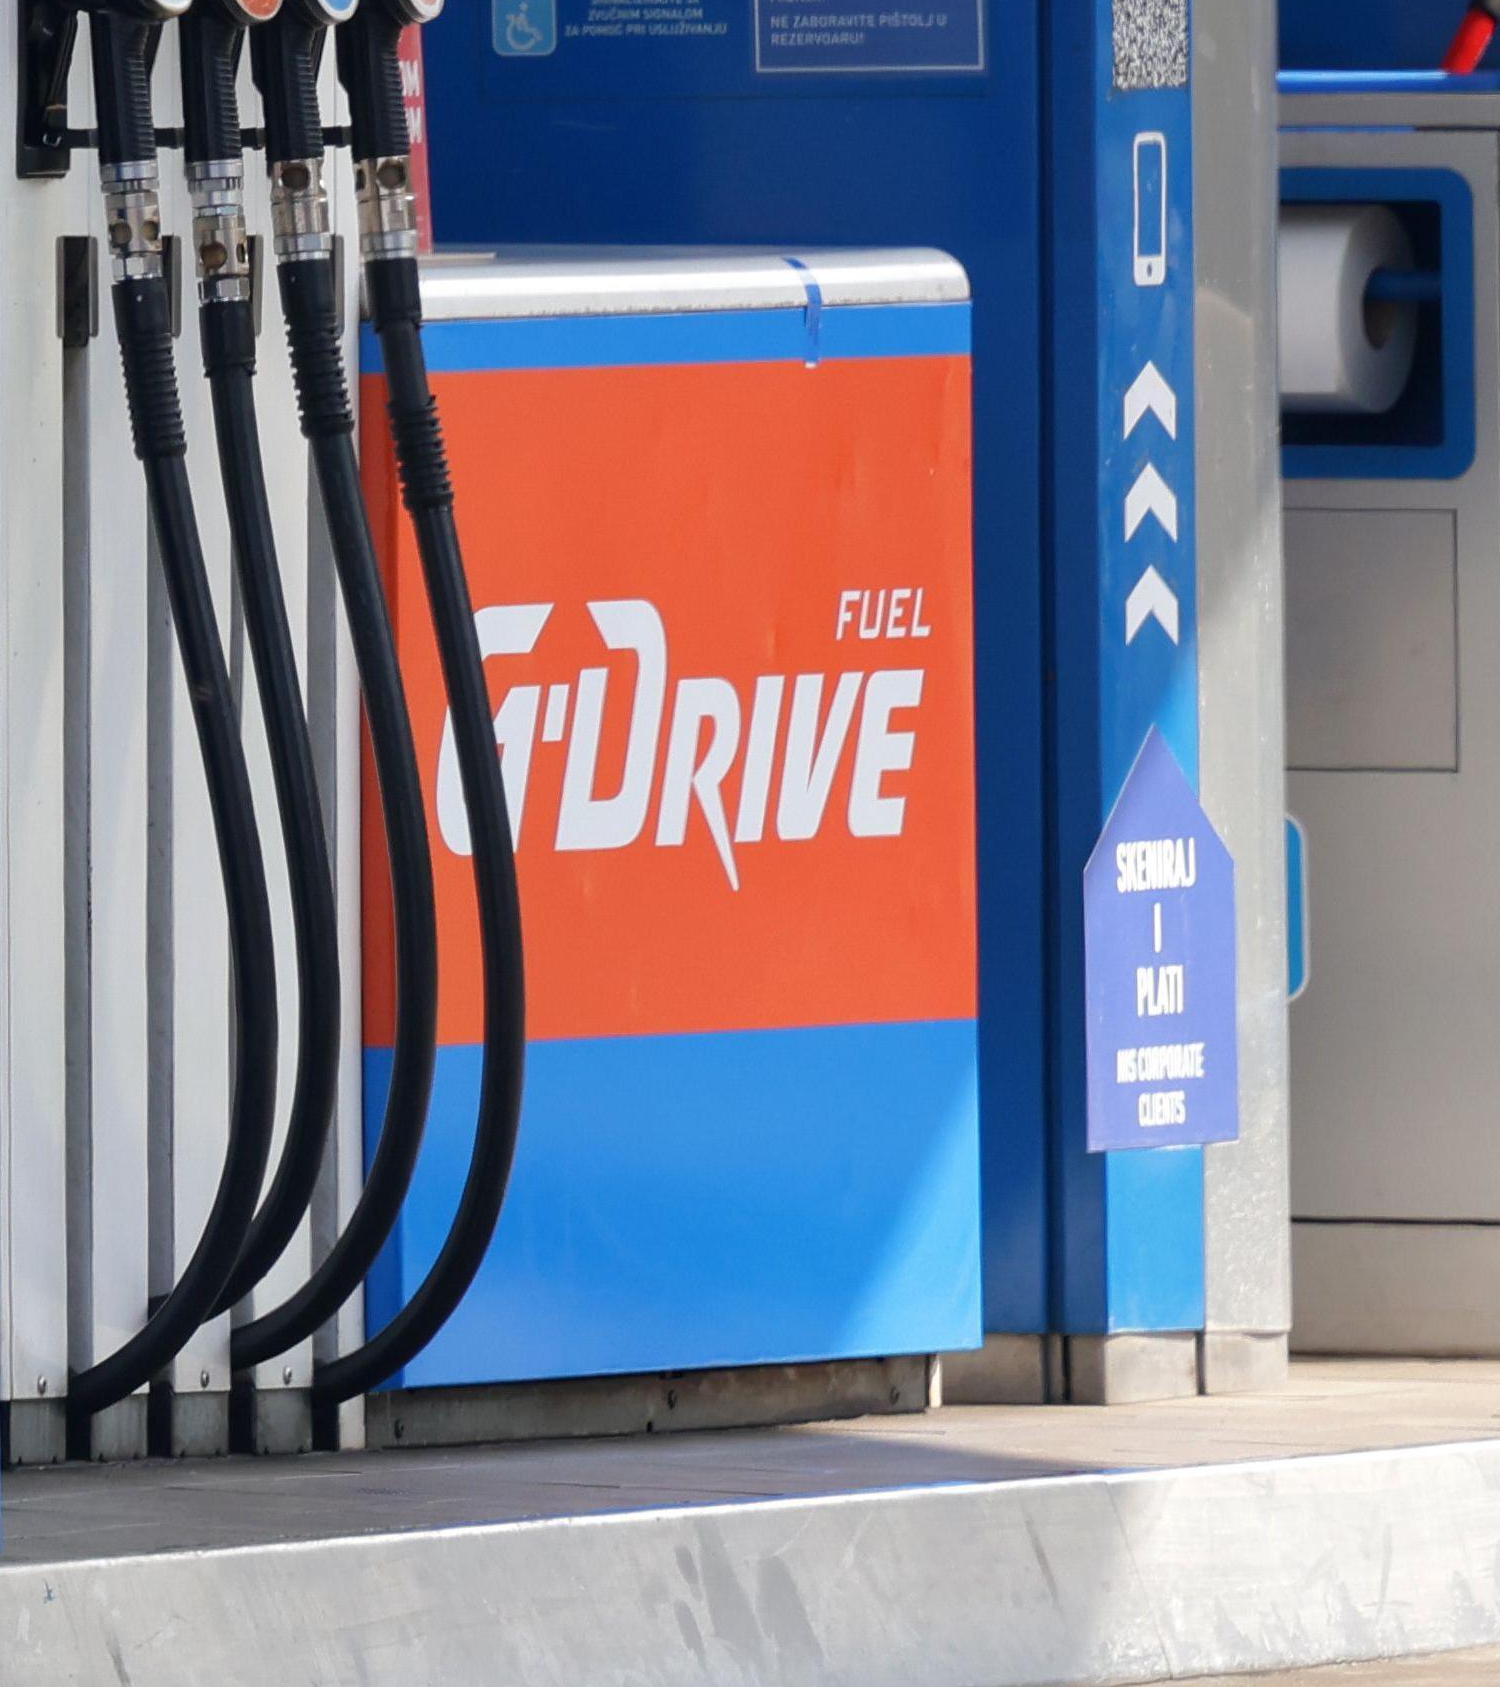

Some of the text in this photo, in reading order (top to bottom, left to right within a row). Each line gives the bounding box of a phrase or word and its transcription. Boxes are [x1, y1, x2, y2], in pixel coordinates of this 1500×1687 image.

[836, 588, 931, 640] FUEL
[1116, 838, 1195, 892] SKENIRAJ
[1136, 965, 1184, 1016] PLATI
[1138, 1042, 1204, 1081] CORPORATE
